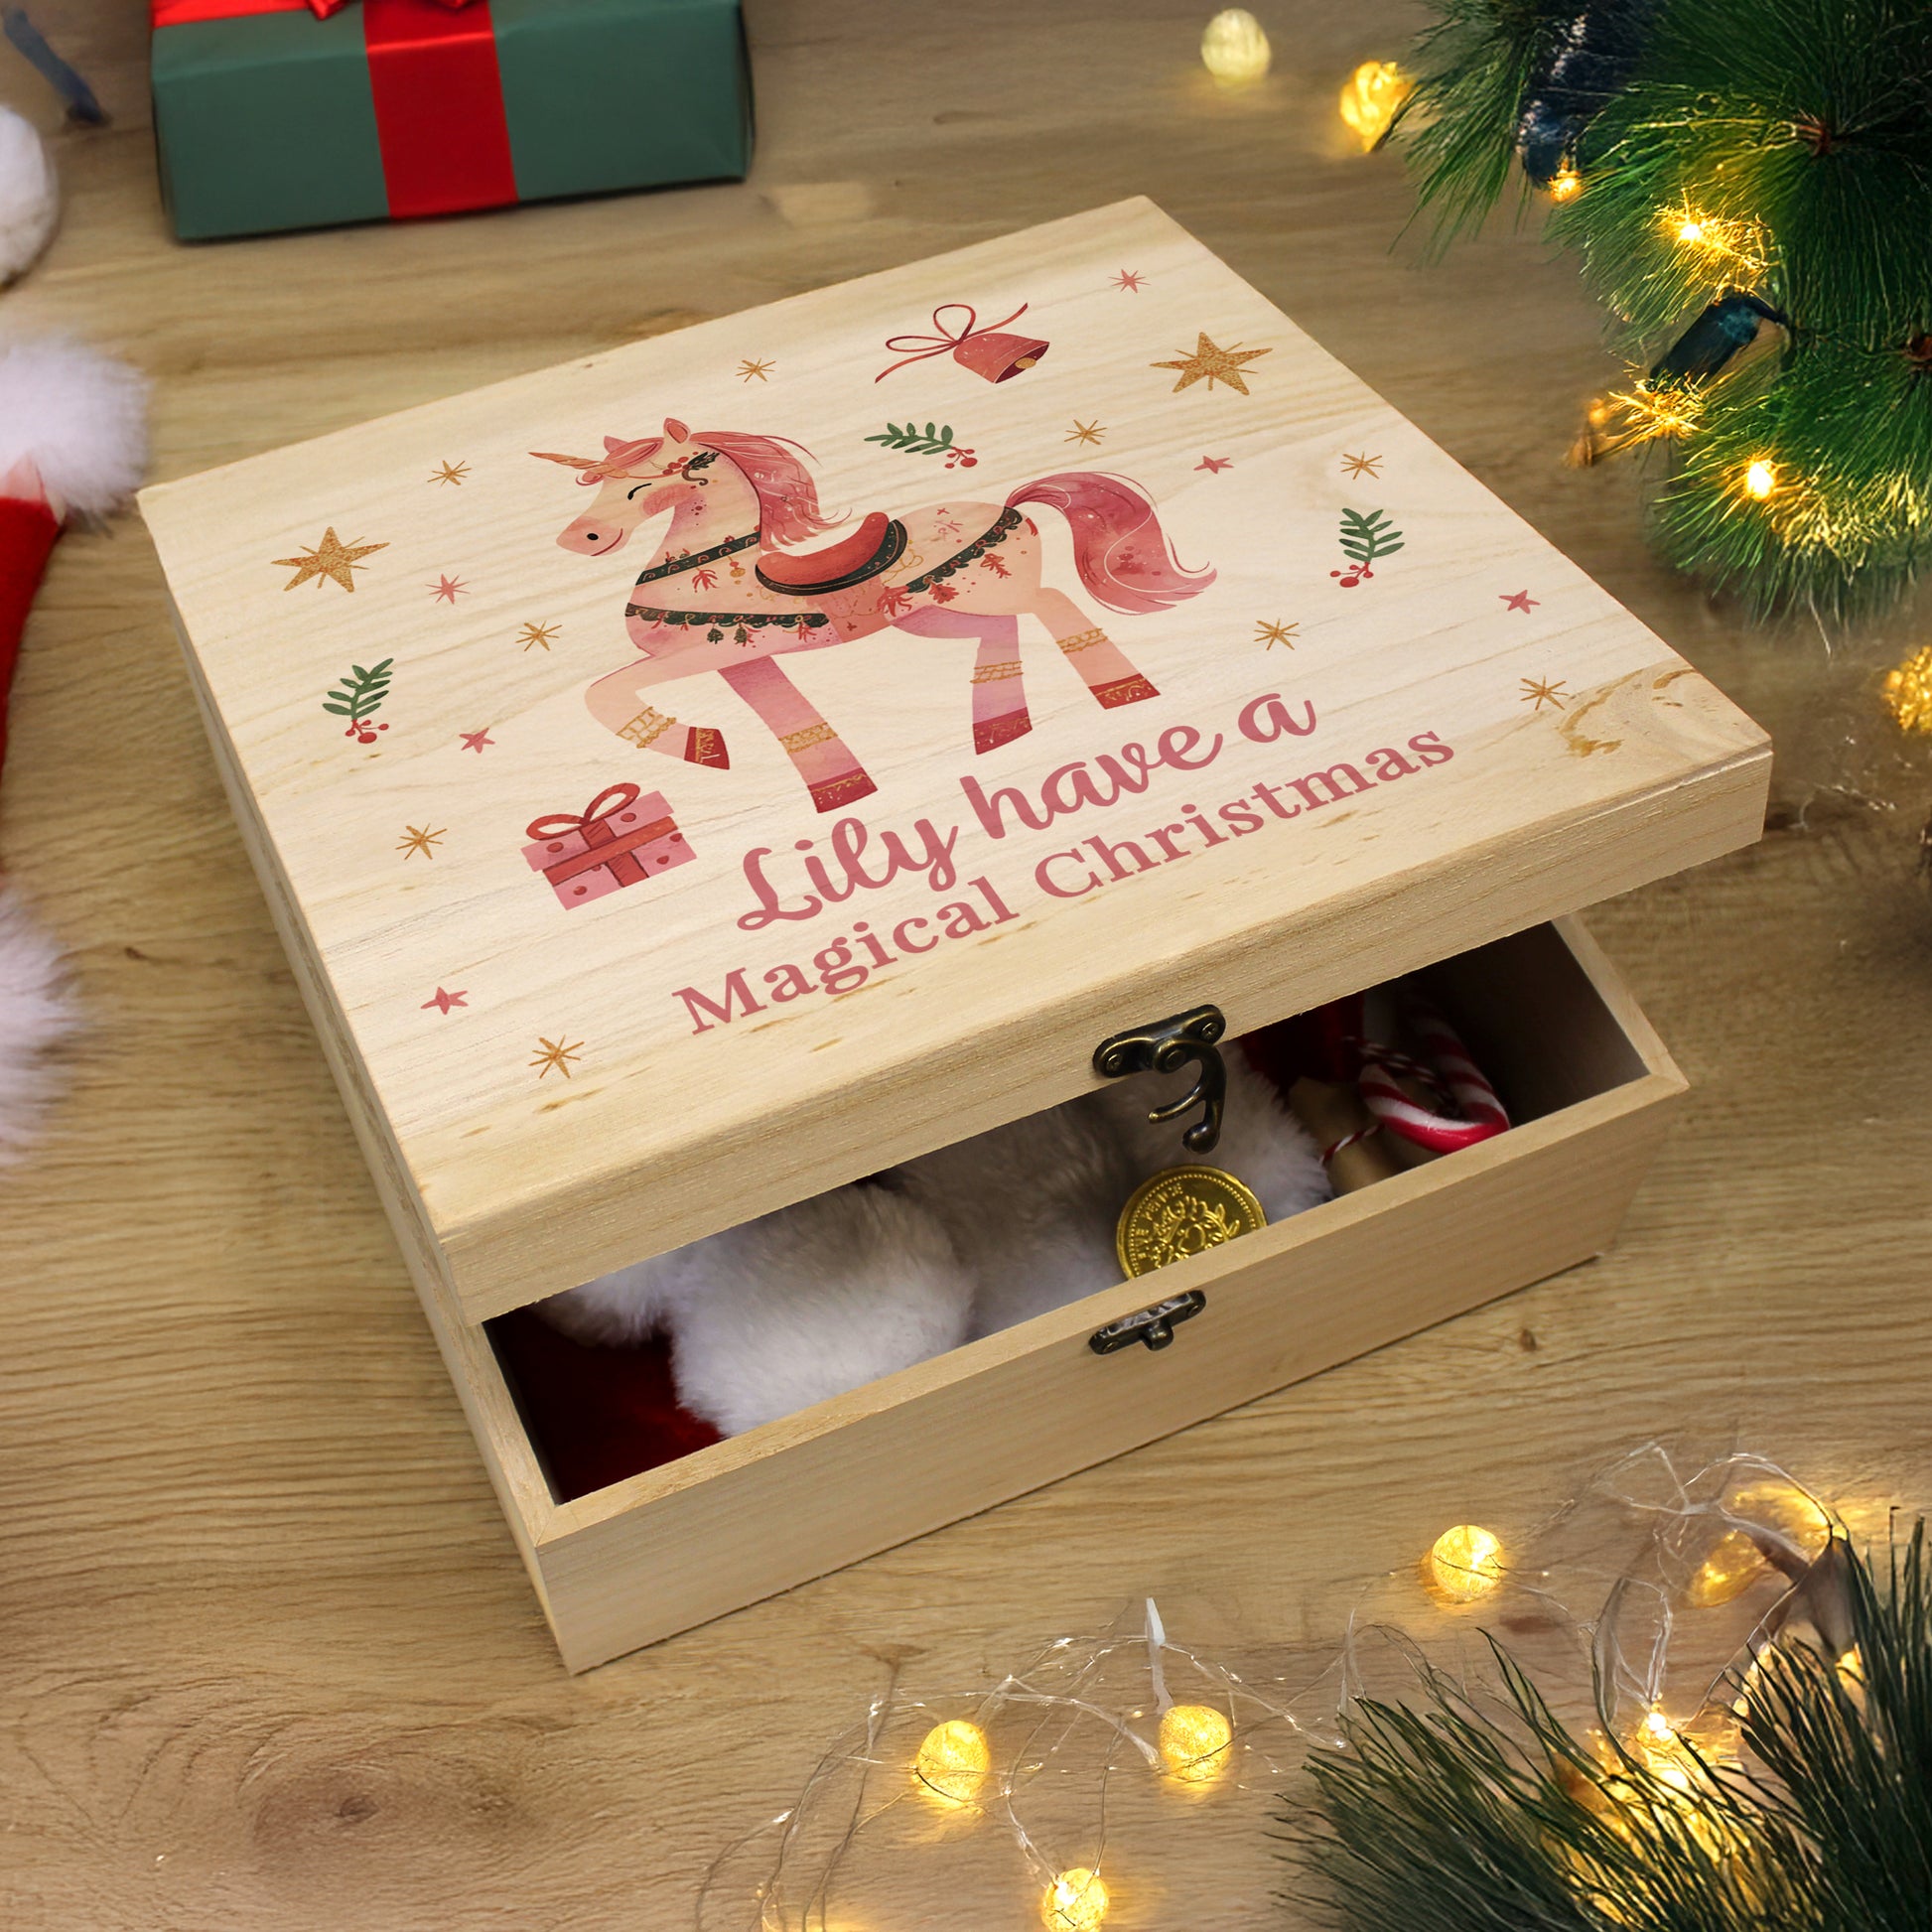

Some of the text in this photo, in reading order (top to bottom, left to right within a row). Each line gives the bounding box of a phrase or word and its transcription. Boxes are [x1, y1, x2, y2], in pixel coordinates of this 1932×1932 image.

[672, 730, 1454, 1035] Magical Christmas
[737, 693, 1316, 931] Lily have a
